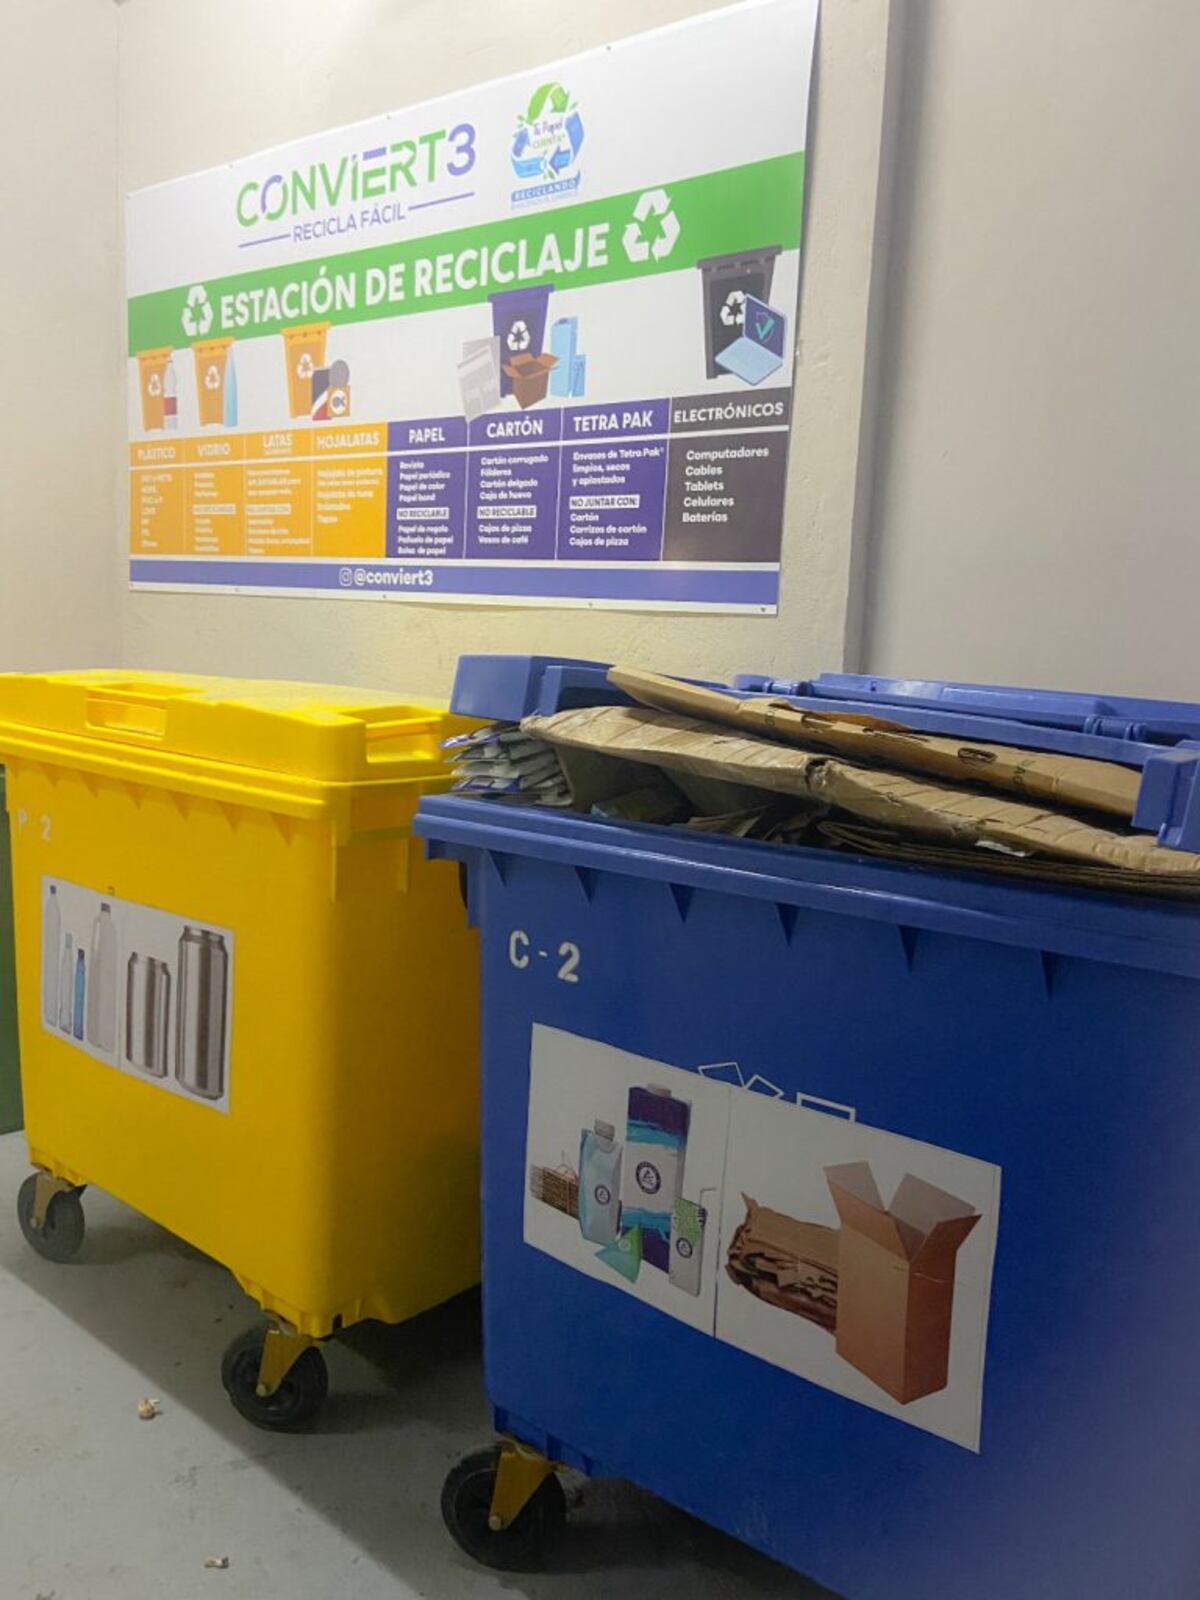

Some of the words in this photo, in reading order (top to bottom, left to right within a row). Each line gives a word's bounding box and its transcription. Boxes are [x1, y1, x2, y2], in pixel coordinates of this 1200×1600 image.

[293, 213, 357, 242] RECICLA
[360, 203, 406, 229] FÁCIL
[220, 265, 357, 329] ESTACIÓN
[365, 261, 406, 307] DE
[414, 222, 611, 298] RECICLAJE
[674, 402, 784, 424] ELECTRÓNICOS
[573, 414, 619, 432] TETRA
[622, 410, 653, 429] PAK
[486, 416, 544, 438] CARTÓN
[409, 427, 445, 443] PAPEL
[608, 449, 618, 459] de
[619, 448, 642, 458] Tetra
[686, 446, 769, 461] Computadores
[508, 454, 549, 465] corrugado
[606, 463, 630, 472] secos
[685, 465, 723, 476] Cables
[507, 478, 538, 489] delgado
[579, 475, 626, 486] aplastados
[685, 480, 724, 492] Tablets
[498, 491, 508, 499] de
[571, 498, 583, 507] NO
[584, 497, 615, 507] JUNTAR
[683, 495, 735, 508] Celulares
[479, 507, 491, 517] NO
[492, 506, 535, 517] RECICLABLE
[571, 512, 599, 522] Cartón
[682, 511, 728, 523] Baterías
[501, 524, 510, 532] de
[606, 524, 616, 533] de
[618, 523, 647, 533] cartón
[425, 535, 433, 543] de
[501, 535, 511, 544] de
[594, 537, 605, 546] de
[606, 537, 629, 548] pizza
[417, 546, 425, 554] de
[354, 567, 434, 586] @conviert3
